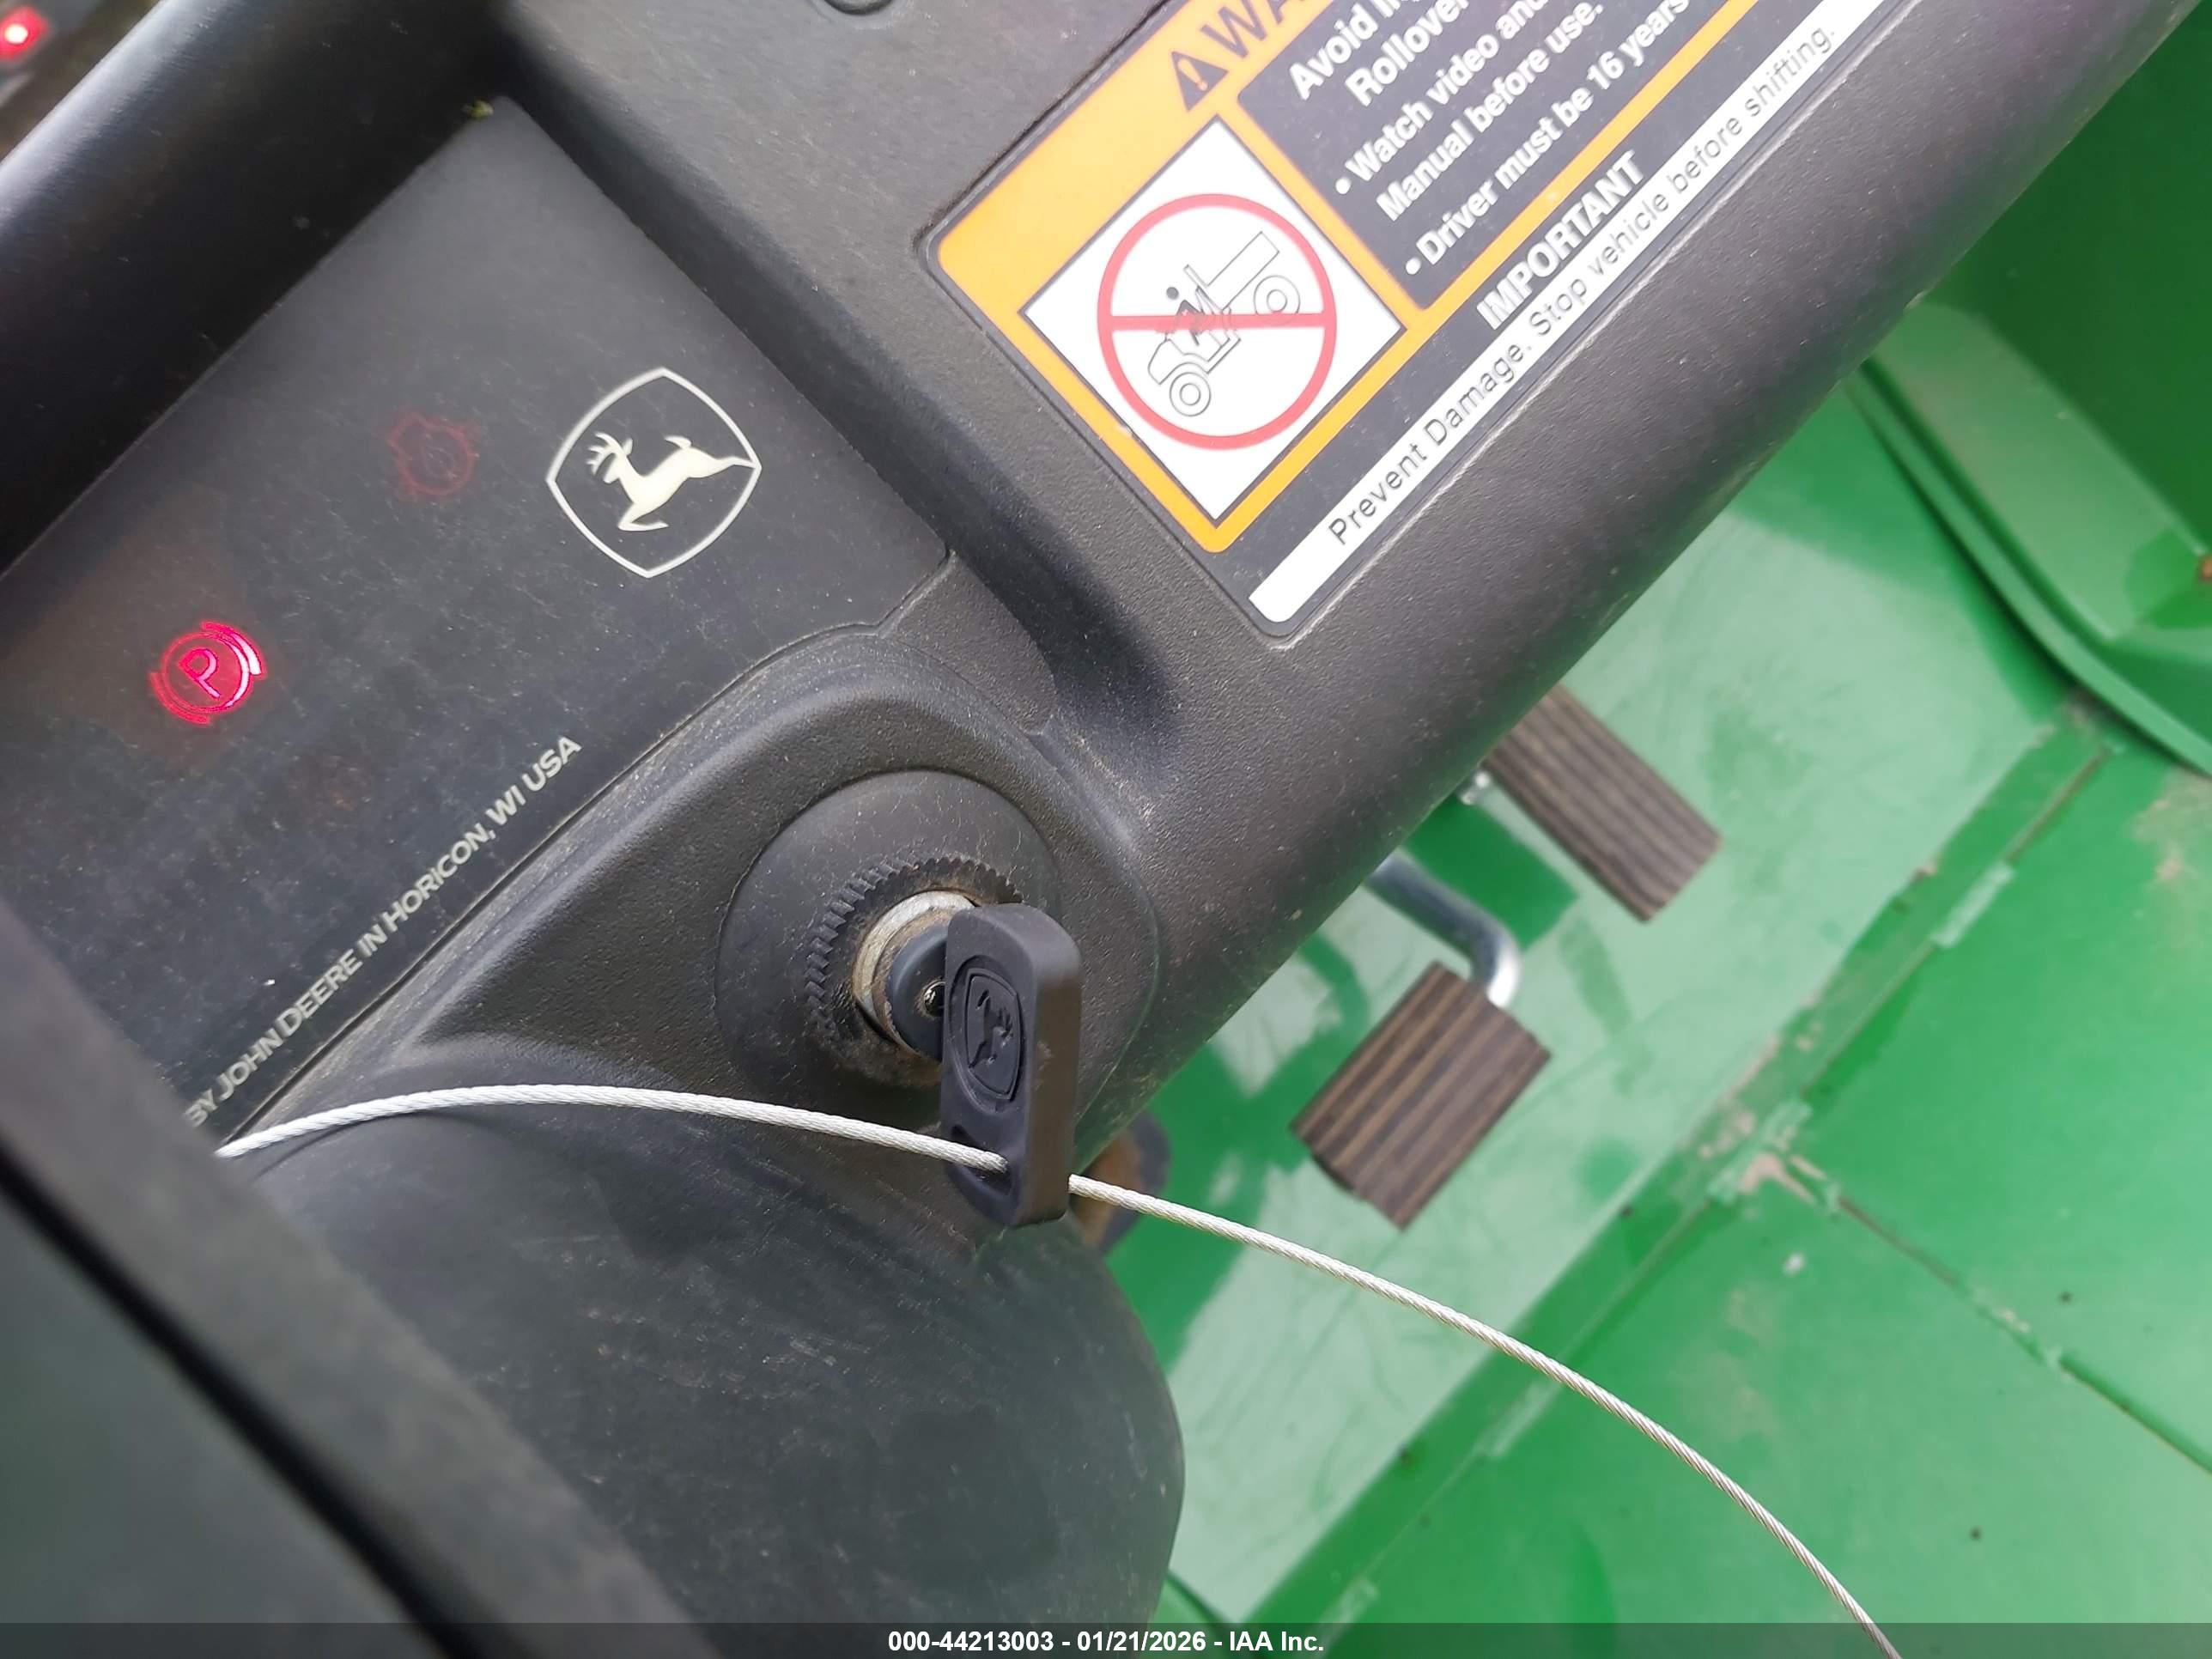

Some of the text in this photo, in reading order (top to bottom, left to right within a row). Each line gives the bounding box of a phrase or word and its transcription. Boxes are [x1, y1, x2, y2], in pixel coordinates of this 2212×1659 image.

[1289, 3, 1379, 100] Avoid
[1345, 0, 1469, 106] Rollove
[1345, 99, 1434, 181] Watch
[1425, 33, 1500, 105] video
[1376, 2, 1604, 222] Manual before use.
[1415, 177, 1498, 265] Driver
[1495, 117, 1563, 190] must
[1552, 87, 1594, 128] be
[1586, 51, 1626, 89] 16
[1476, 149, 1644, 330] IMPORTANT
[1328, 27, 1836, 545] Prevent Damage. Stop vehicle before shifting.
[216, 1028, 285, 1102] JOHN
[276, 950, 363, 1038] DEERE
[356, 923, 389, 957] IN
[382, 823, 496, 932] HORICON,
[485, 786, 528, 826] WI
[522, 736, 583, 792] USA
